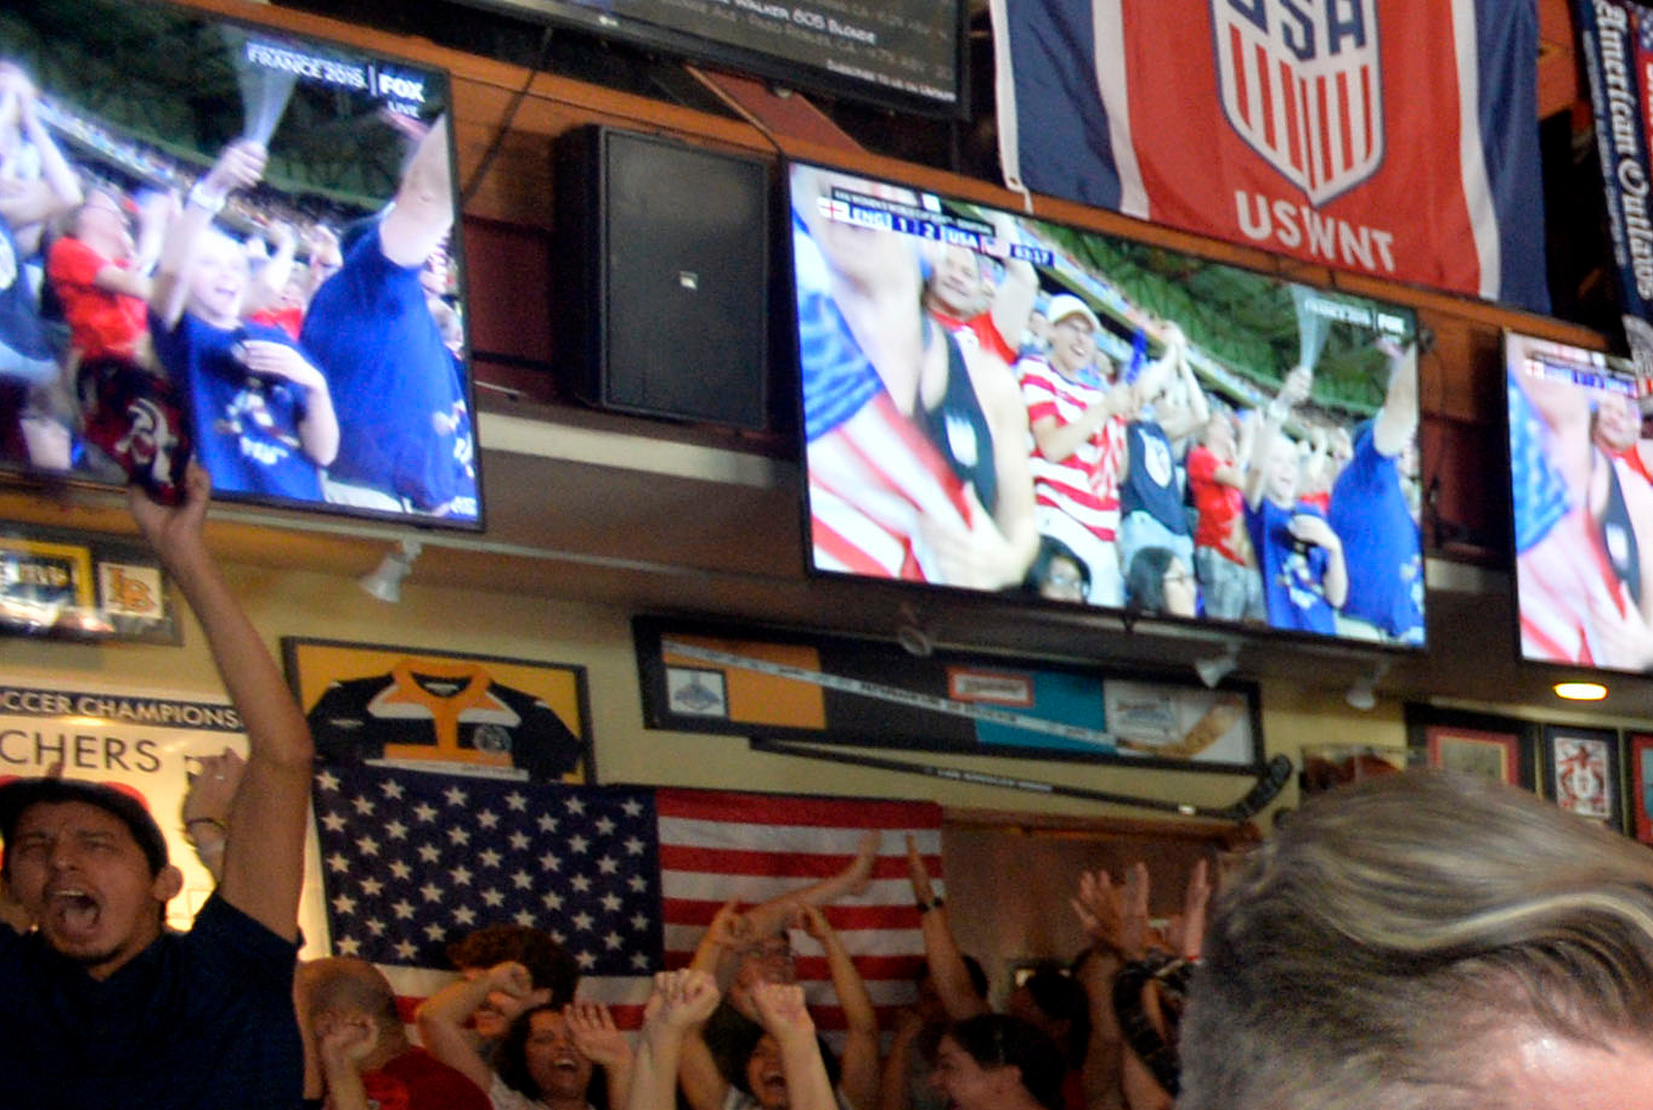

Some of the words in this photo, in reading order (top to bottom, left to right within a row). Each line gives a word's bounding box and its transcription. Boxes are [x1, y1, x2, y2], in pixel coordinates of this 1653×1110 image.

[378, 73, 426, 103] FOX
[949, 228, 980, 248] USA
[1235, 190, 1396, 273] USWNT
[0, 689, 72, 714] CCER
[0, 729, 161, 773] CHERS
